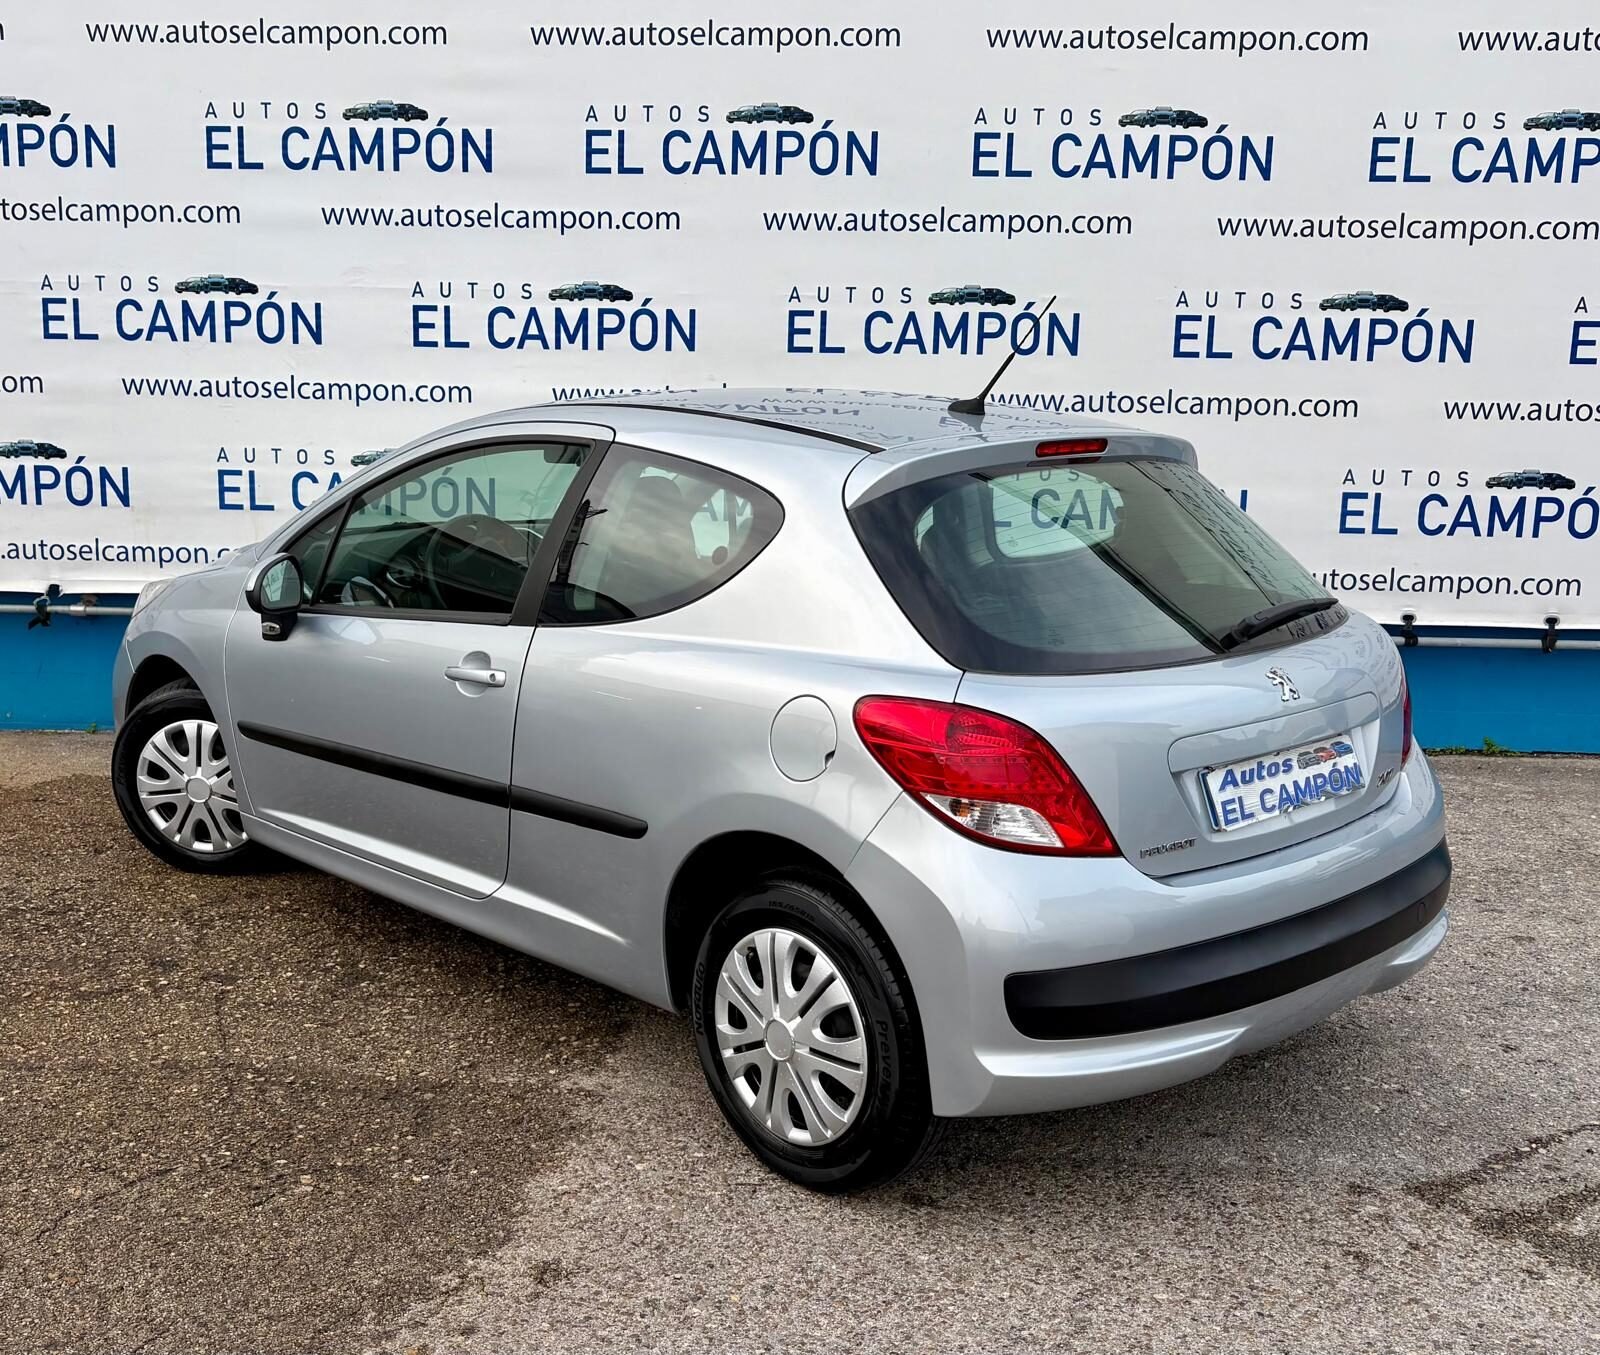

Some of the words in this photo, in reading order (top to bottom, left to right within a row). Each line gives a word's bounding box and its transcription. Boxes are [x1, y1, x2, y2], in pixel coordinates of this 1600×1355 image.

[86, 18, 446, 51] www.autoselcampon.com
[531, 19, 900, 53] www.autoselcampon.com
[987, 23, 1368, 57] www.autoselcampon.com
[205, 102, 326, 119] AUTOS
[585, 105, 709, 122] AUTOS
[974, 108, 1101, 126] AUTOS
[1373, 112, 1505, 129] AUTOS
[206, 126, 264, 169] EL
[282, 117, 492, 173] CAMPÓN
[586, 130, 643, 174] EL
[663, 119, 878, 176] CAMPÓN
[973, 132, 1032, 177] EL
[1052, 123, 1273, 181] CAMPÓN
[1369, 137, 1431, 182] EL
[322, 203, 680, 235] www.autoselcampon.com
[763, 206, 1131, 239] www.autoselcampon.com
[1218, 213, 1599, 246] www.autoselcampon.com
[41, 275, 158, 292] AUTOS
[412, 282, 532, 299] AUTOS
[789, 287, 911, 303] AUTOS
[1176, 291, 1302, 309] AUTOS
[42, 298, 99, 340] EL
[116, 290, 322, 345] CAMPÓN
[413, 305, 469, 348] EL
[488, 297, 695, 351] CAMPÓN
[788, 310, 845, 353] EL
[863, 302, 1080, 356] CAMPÓN
[1173, 315, 1232, 358] EL
[1253, 306, 1474, 363] CAMPÓN
[122, 375, 471, 406] www.autoselcampon.com
[217, 447, 334, 465] AUTOS
[218, 470, 274, 511] EL
[1343, 469, 1468, 487] AUTOS
[1339, 492, 1398, 535] EL
[1218, 756, 1294, 792] Autos
[1221, 796, 1255, 827] EL
[1259, 761, 1361, 814] CAMPÓN
